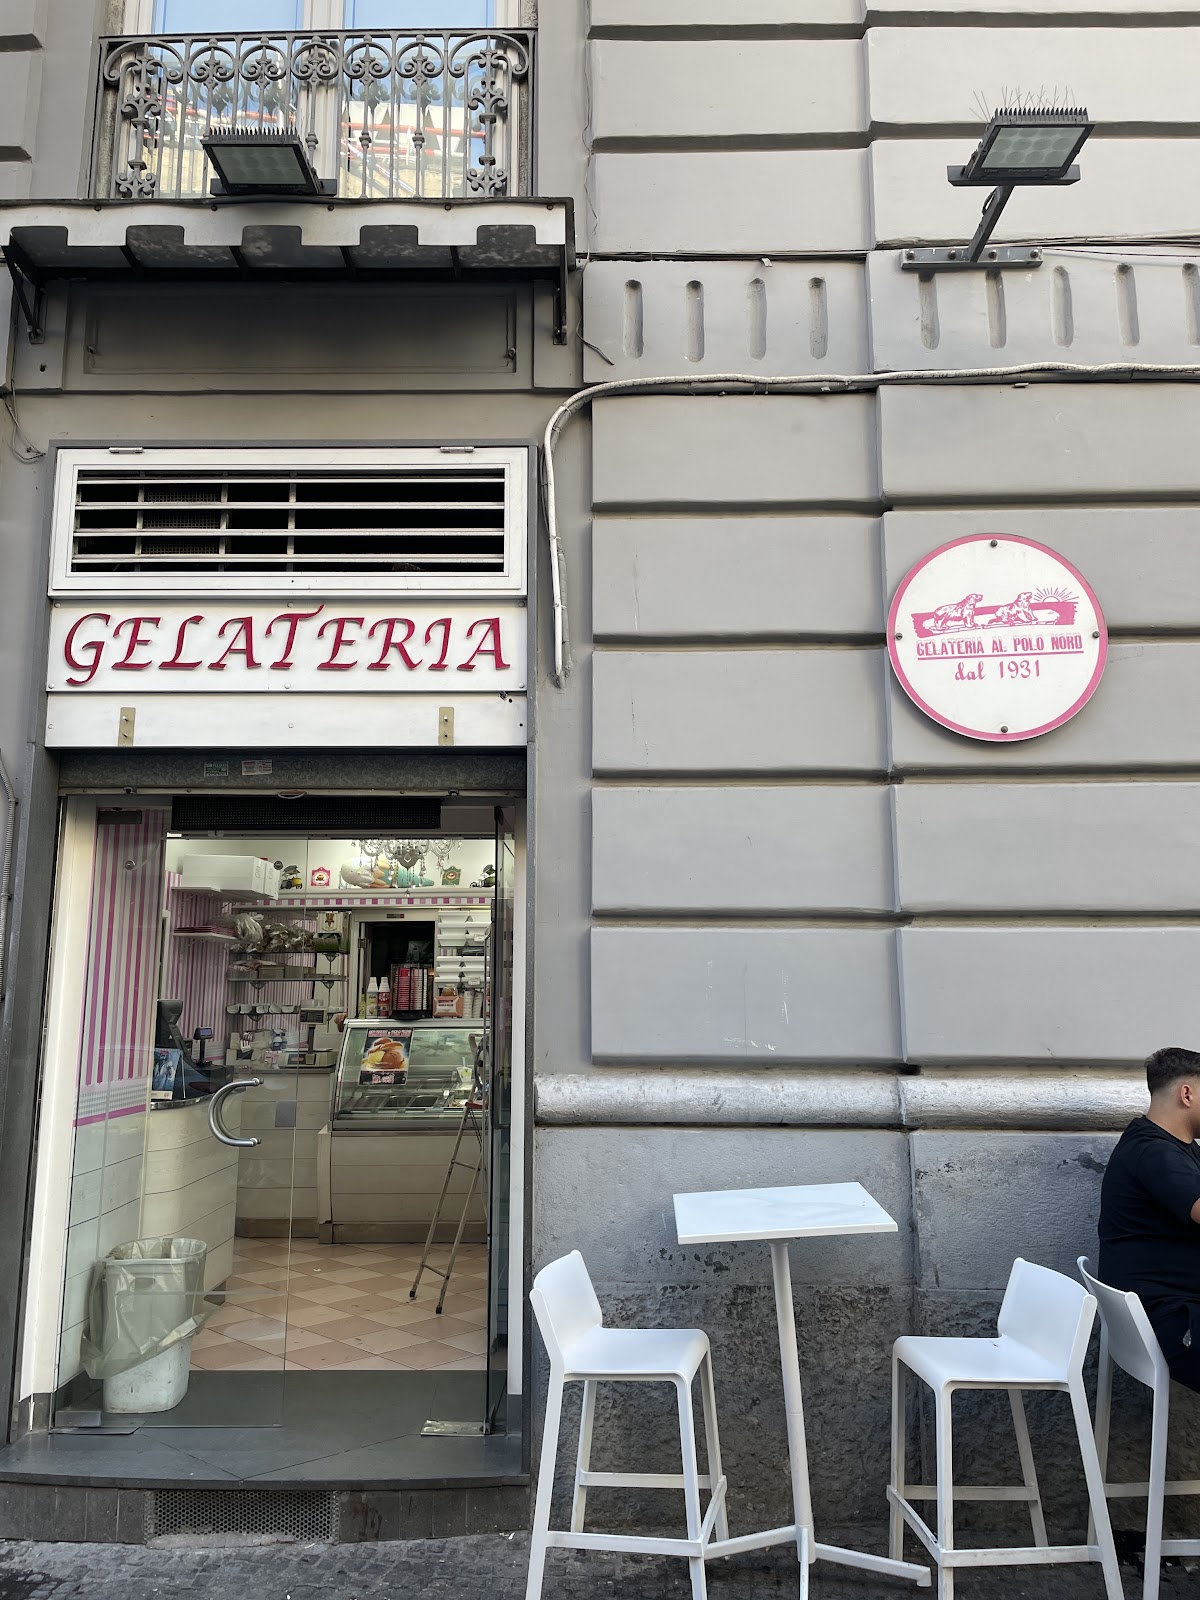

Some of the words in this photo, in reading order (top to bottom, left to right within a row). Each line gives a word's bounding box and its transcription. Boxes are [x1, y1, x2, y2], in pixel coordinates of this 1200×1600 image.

[64, 604, 510, 685] GELATERIA
[916, 638, 985, 656] GELATERIA
[992, 637, 1007, 653] AL
[1014, 636, 1045, 652] POLO
[1051, 634, 1083, 650] NORD
[955, 661, 986, 681] dal
[999, 660, 1040, 679] 1931
